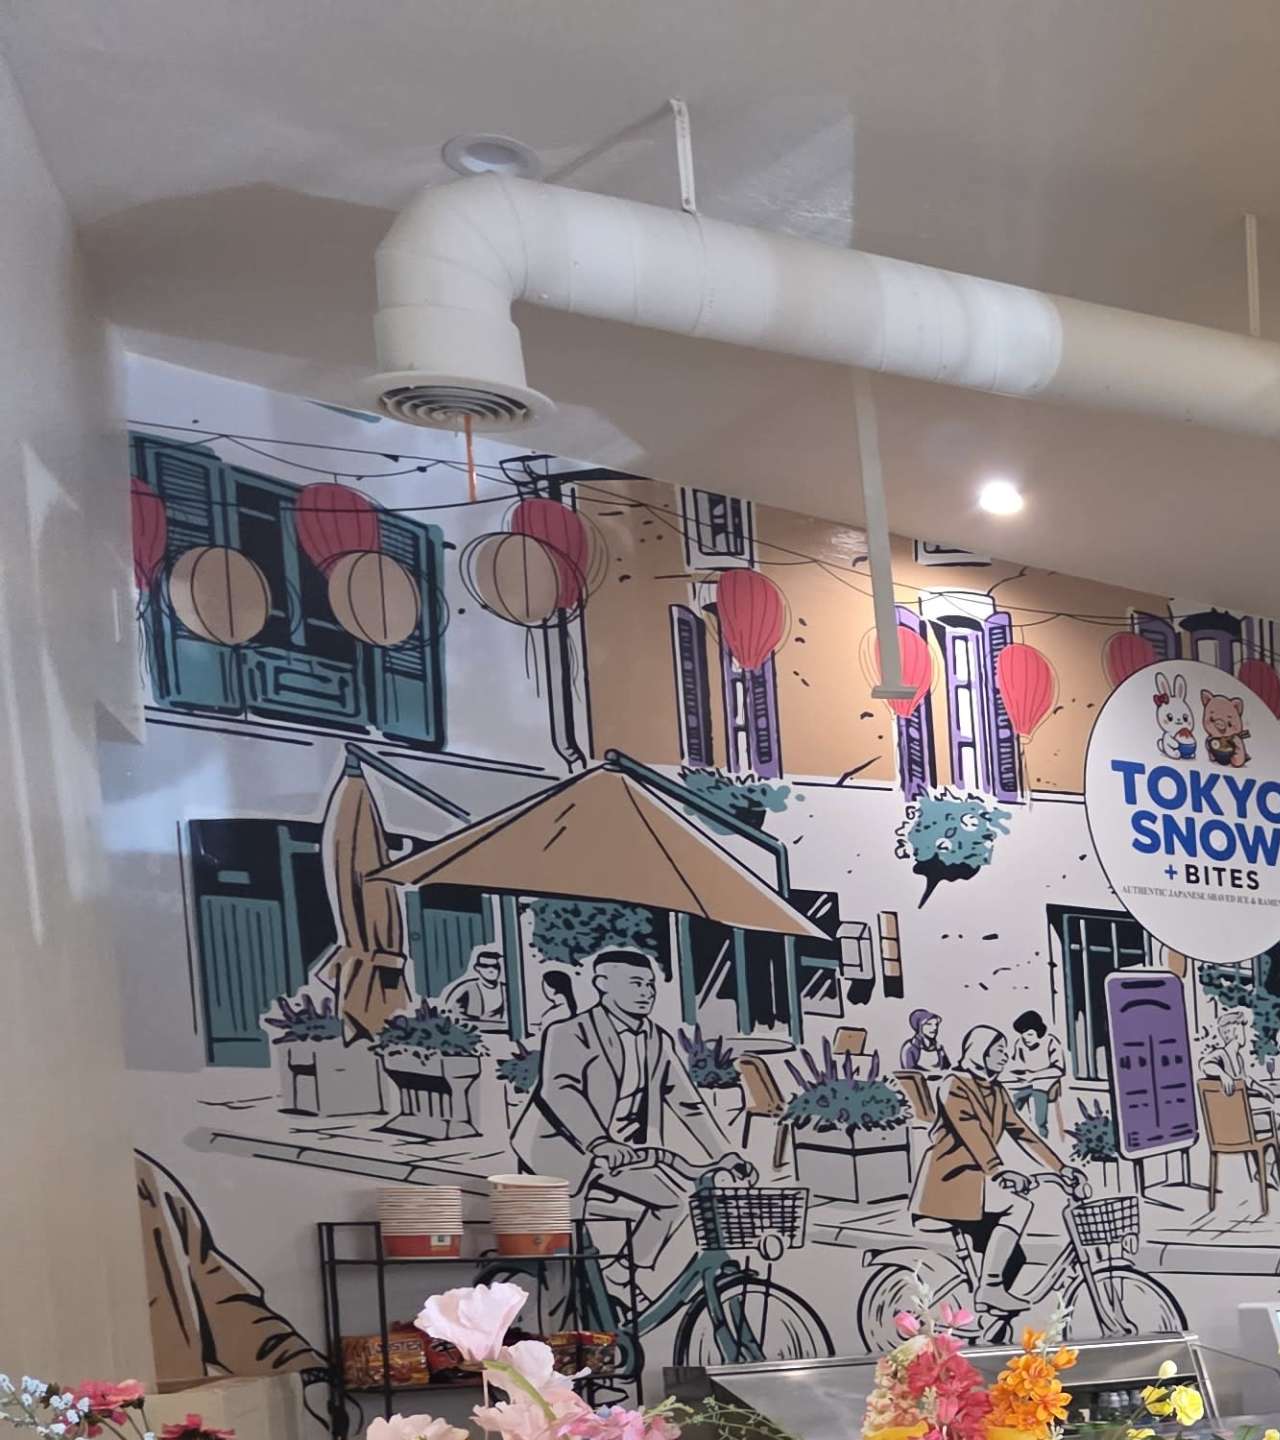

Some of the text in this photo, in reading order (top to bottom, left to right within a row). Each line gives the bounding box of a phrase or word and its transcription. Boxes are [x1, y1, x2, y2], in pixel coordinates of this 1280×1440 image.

[1185, 864, 1260, 890] BITES
[1122, 885, 1167, 896] AUTHENTIC
[1168, 889, 1205, 900] JAPANESE
